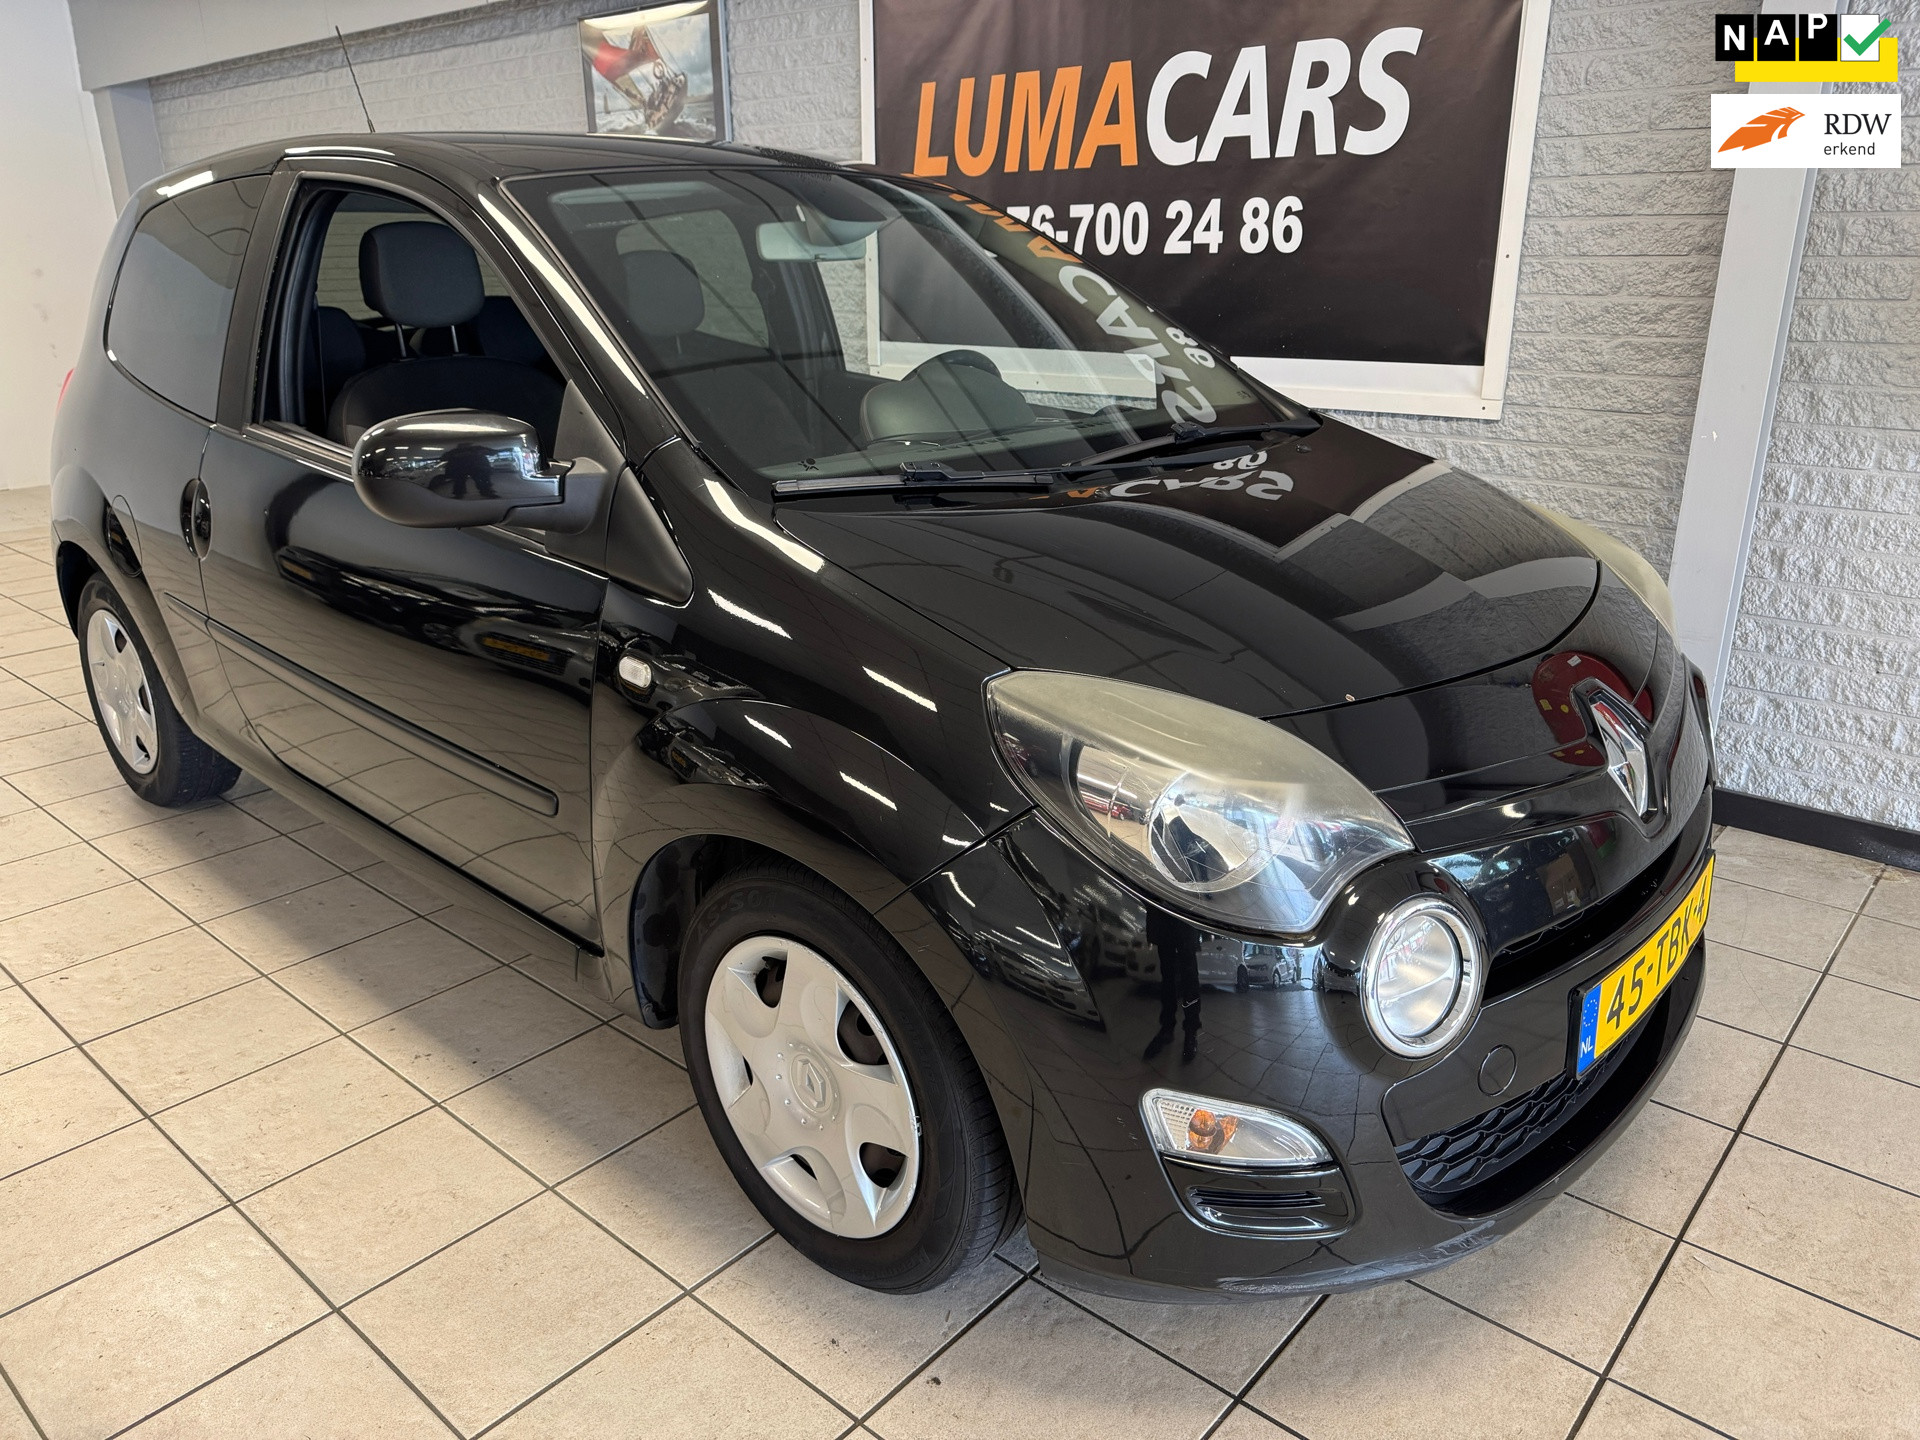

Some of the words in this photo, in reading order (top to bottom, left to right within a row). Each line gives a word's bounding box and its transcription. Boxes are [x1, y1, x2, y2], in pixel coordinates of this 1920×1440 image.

[913, 27, 1424, 177] LUMACARS
[1164, 199, 1224, 254] 24
[1239, 195, 1304, 254] 86
[1606, 875, 1707, 1030] 45-TBK-4
[1580, 1035, 1594, 1058] NL
